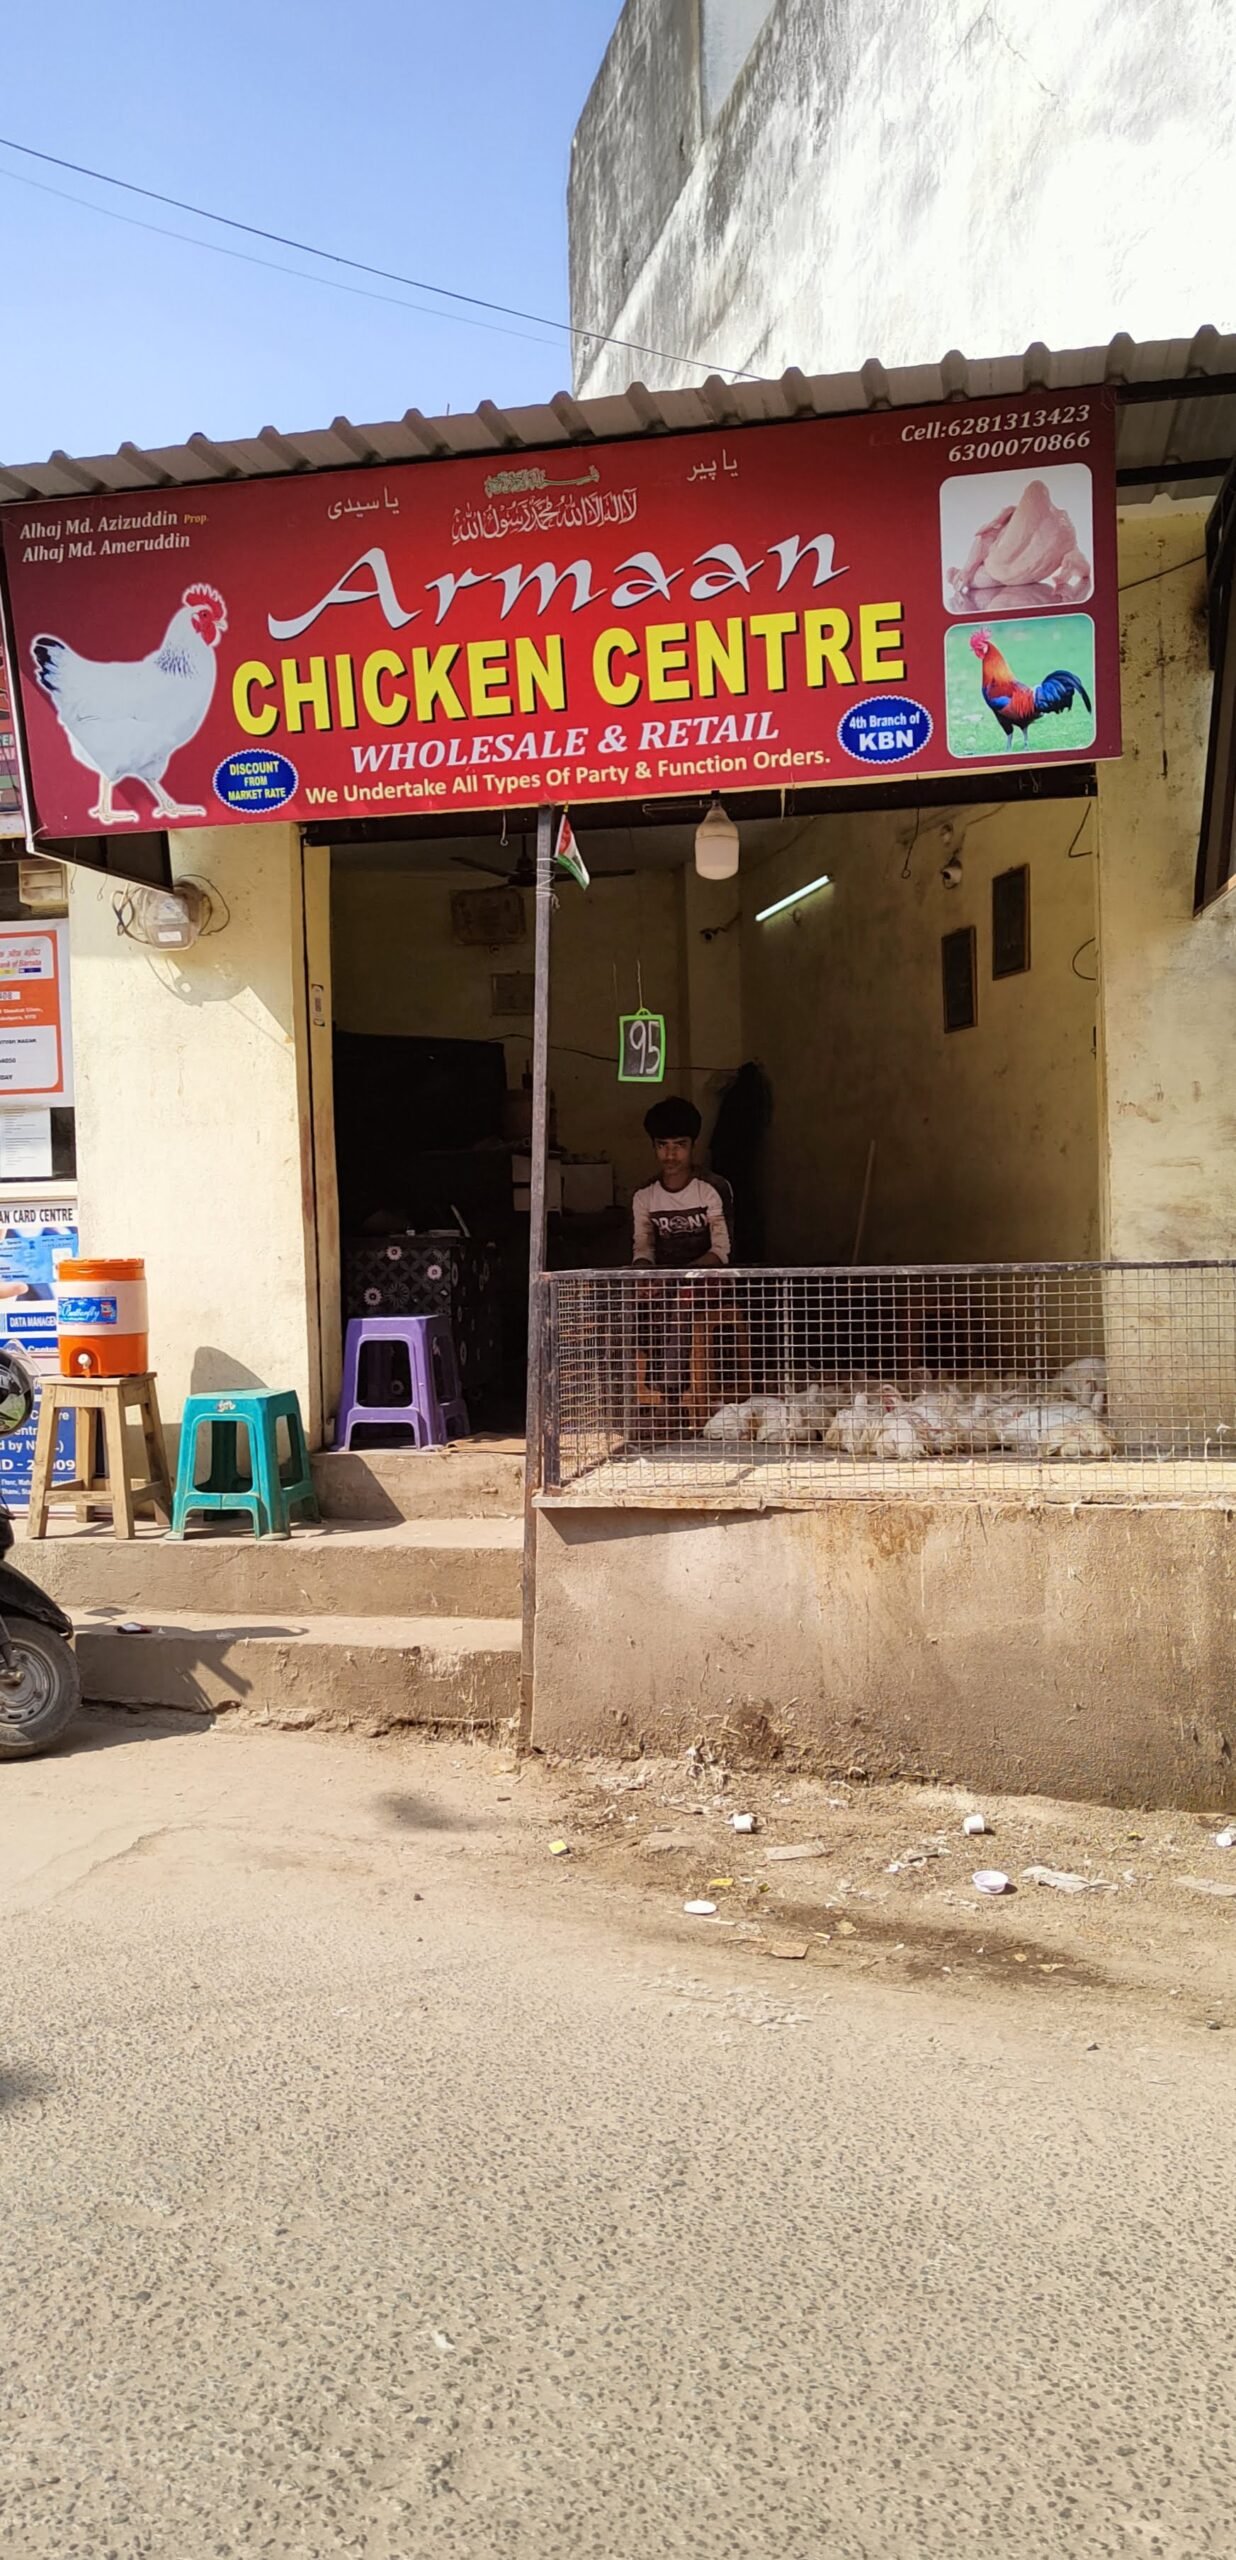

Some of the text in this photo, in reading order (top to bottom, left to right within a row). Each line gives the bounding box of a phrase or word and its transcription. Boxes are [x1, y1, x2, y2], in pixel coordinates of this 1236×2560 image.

[901, 404, 1090, 442] Cell:6281313423
[948, 431, 1091, 462] 6300070866
[19, 520, 62, 540] Alhaj
[65, 517, 94, 536] Md.
[98, 510, 178, 532] Azizuddin
[22, 532, 191, 564] Alhaj Md. Ameruddin
[267, 533, 850, 640] Armaan
[232, 601, 905, 736] CHICKEN CENTRE
[849, 710, 920, 730] 4th Branch of
[351, 711, 780, 773] WHOLESALE & RETAIL
[859, 729, 914, 752] KBN
[229, 761, 280, 776] DISCOUNT
[244, 775, 268, 787] FROM
[305, 748, 831, 805] We Undertake All Types Of Party & Function Orders.
[228, 787, 287, 801] MARKET RATE
[629, 1020, 661, 1074] 95
[13, 1209, 37, 1223] CARD
[39, 1207, 74, 1222] CENTRE
[8, 1441, 23, 1453] by
